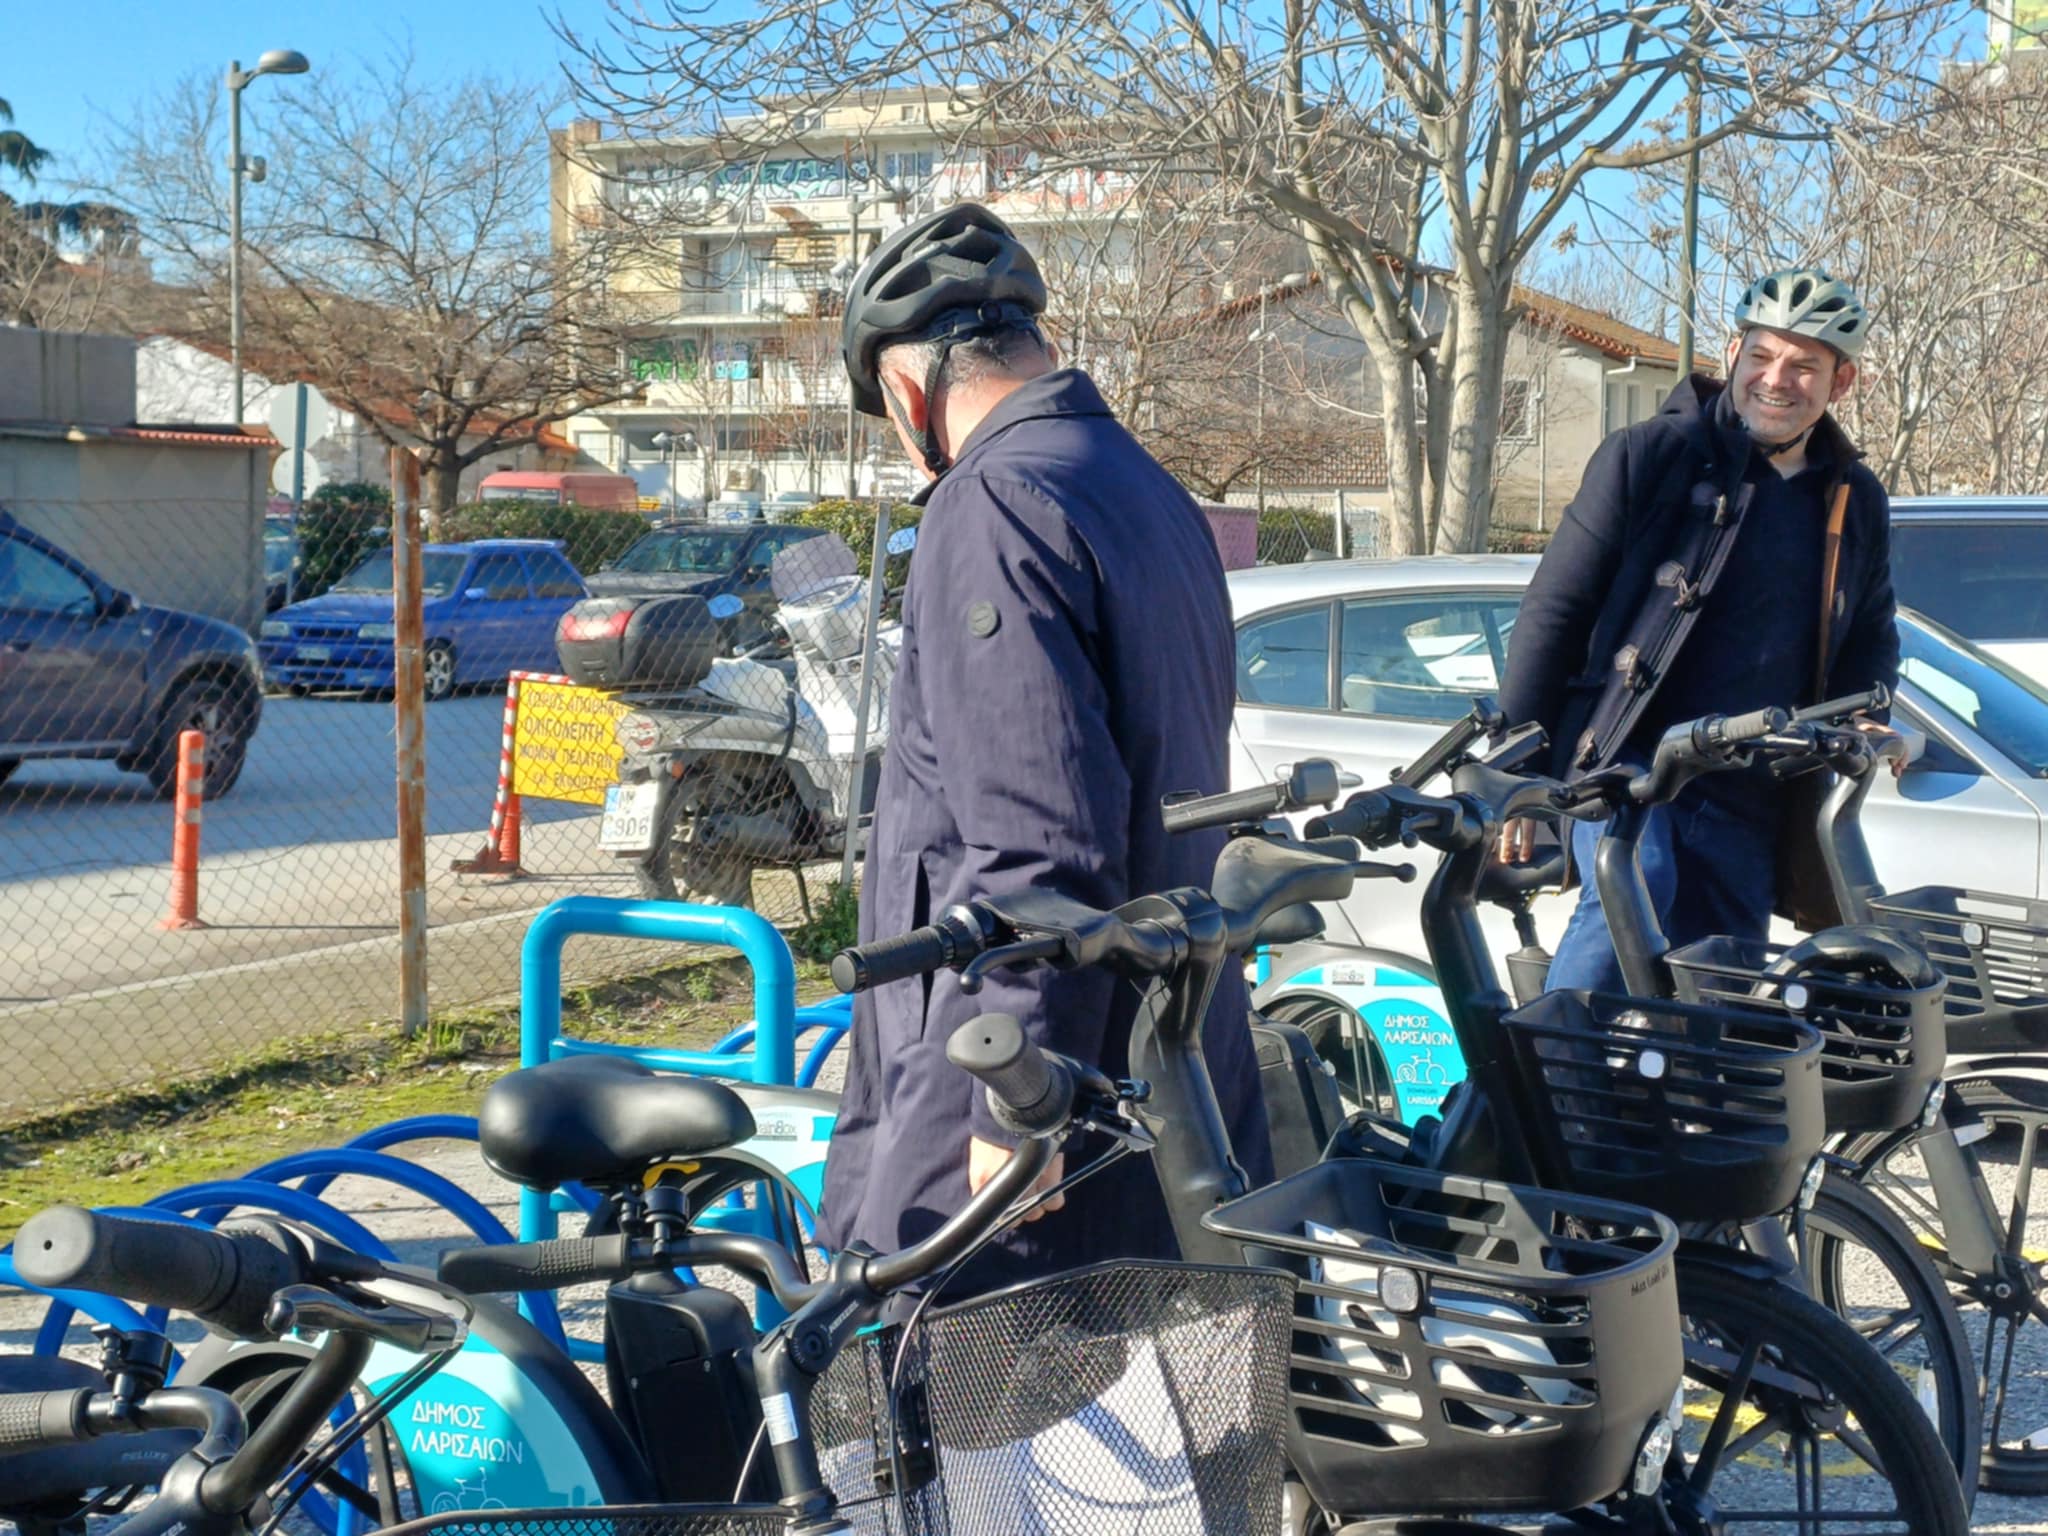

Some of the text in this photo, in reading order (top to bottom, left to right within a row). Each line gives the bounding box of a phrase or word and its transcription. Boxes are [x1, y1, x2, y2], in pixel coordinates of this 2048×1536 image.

[1384, 1015, 1430, 1029] ΔΗΜΟΣ
[1384, 1030, 1454, 1046] ΛΑΡΙΣΑΙΩΝ
[411, 1400, 486, 1430] ΔΗΜΟΣ
[411, 1429, 523, 1465] ΛΑΡΙΣΑΙΩΝ
